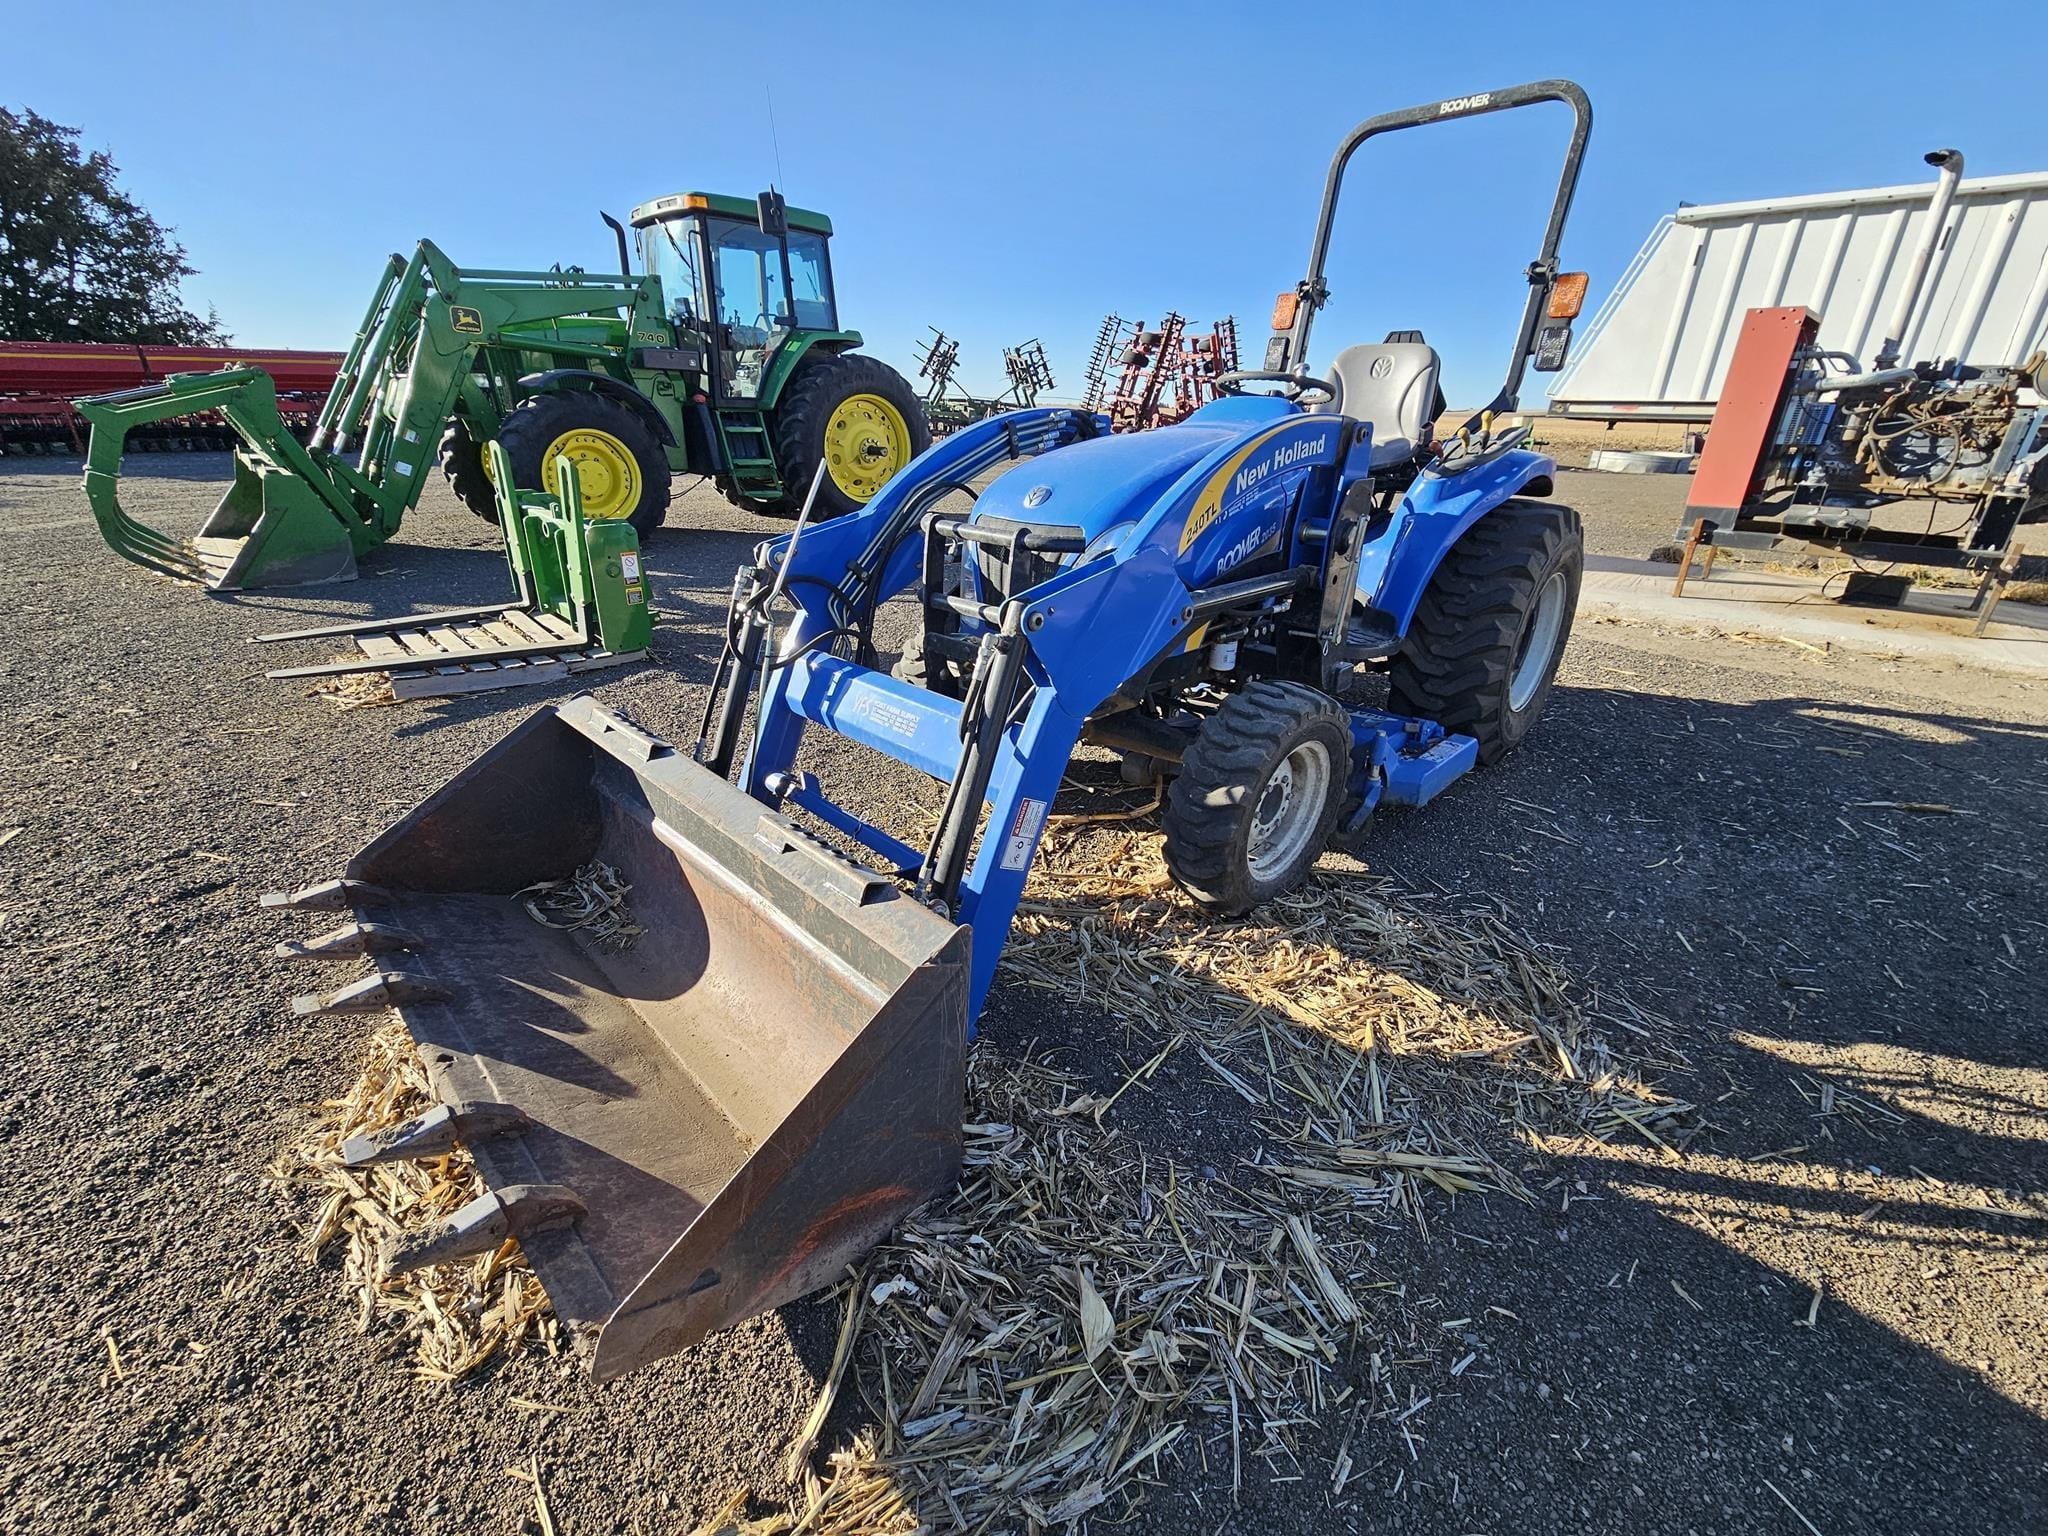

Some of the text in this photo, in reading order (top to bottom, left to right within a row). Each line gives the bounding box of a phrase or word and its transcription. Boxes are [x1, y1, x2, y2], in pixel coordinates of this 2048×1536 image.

[1440, 93, 1490, 114] BOOMER
[637, 331, 666, 345] 740
[1236, 433, 1326, 495] New Holland
[1186, 502, 1218, 545] 240TL
[1216, 526, 1261, 577] BOOMER
